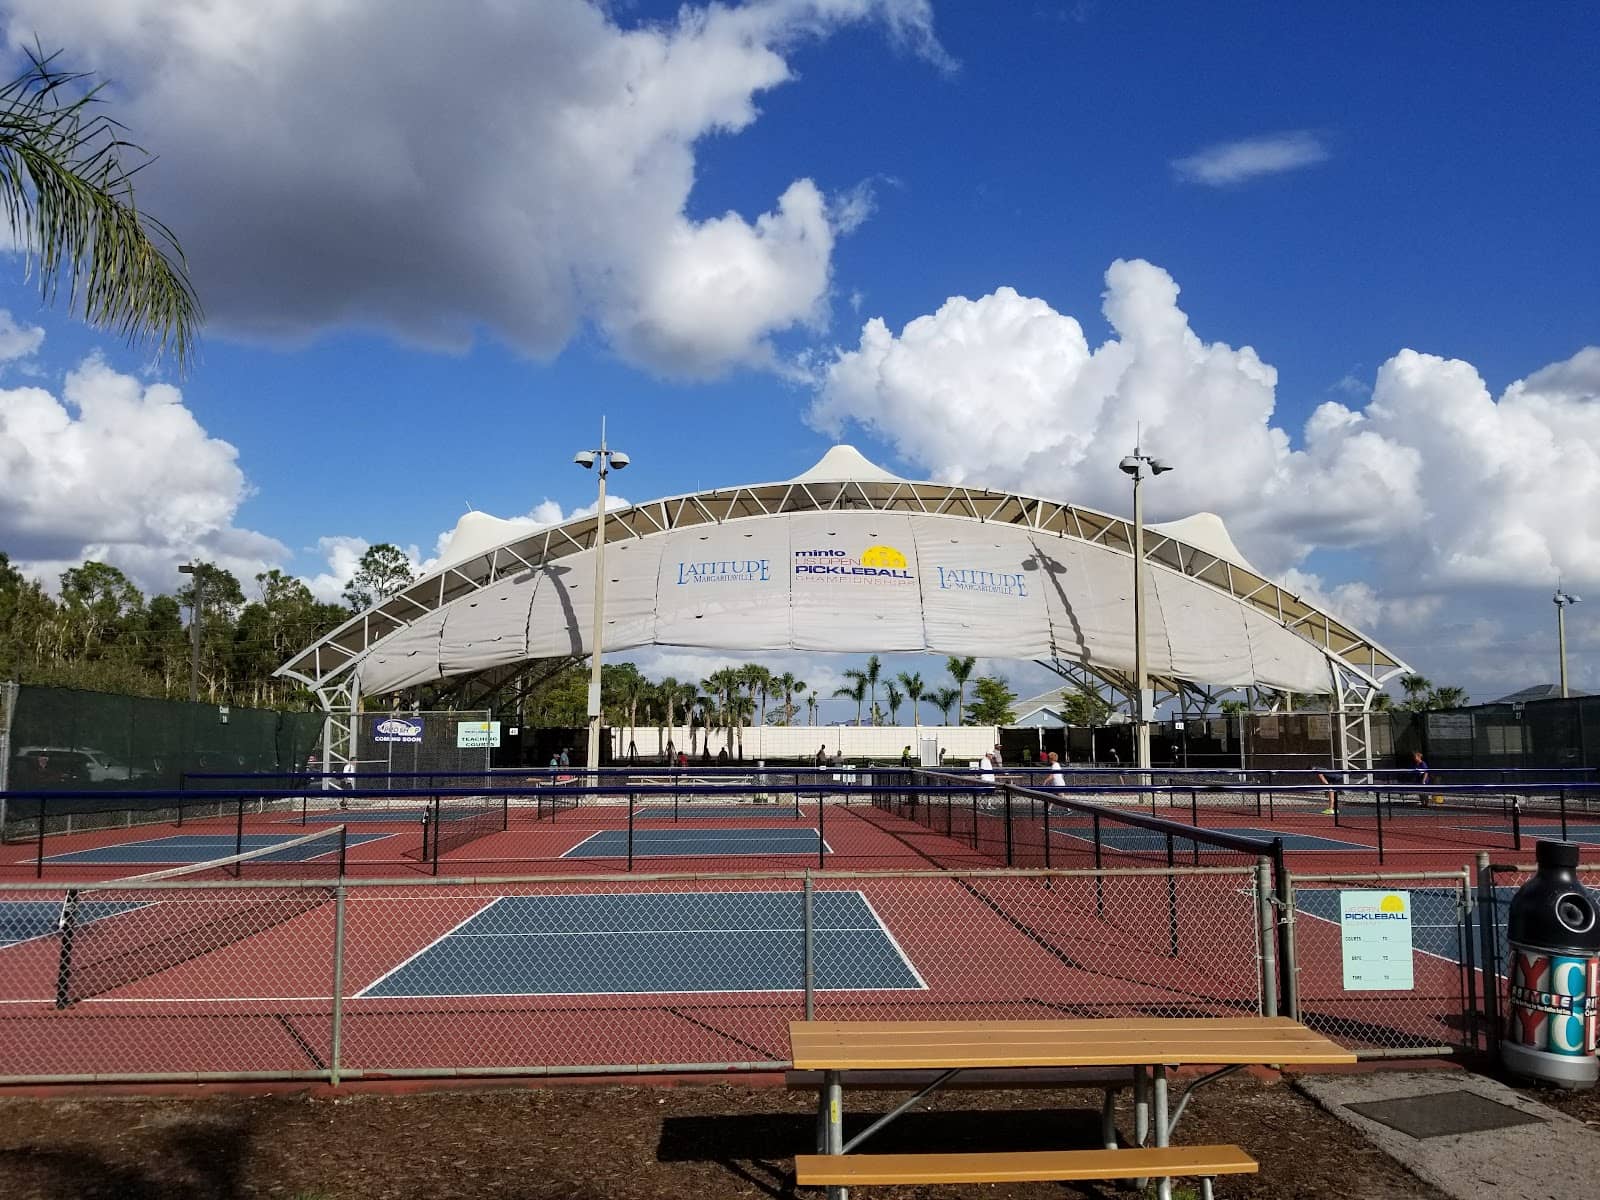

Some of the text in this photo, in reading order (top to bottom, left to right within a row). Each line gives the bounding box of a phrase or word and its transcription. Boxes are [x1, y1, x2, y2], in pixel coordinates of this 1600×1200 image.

[795, 549, 847, 557] minto
[795, 558, 861, 566] US OPEN
[677, 559, 771, 585] LATITUDE
[796, 566, 915, 579] PICKLEBALL
[937, 566, 1029, 597] LATITUDE
